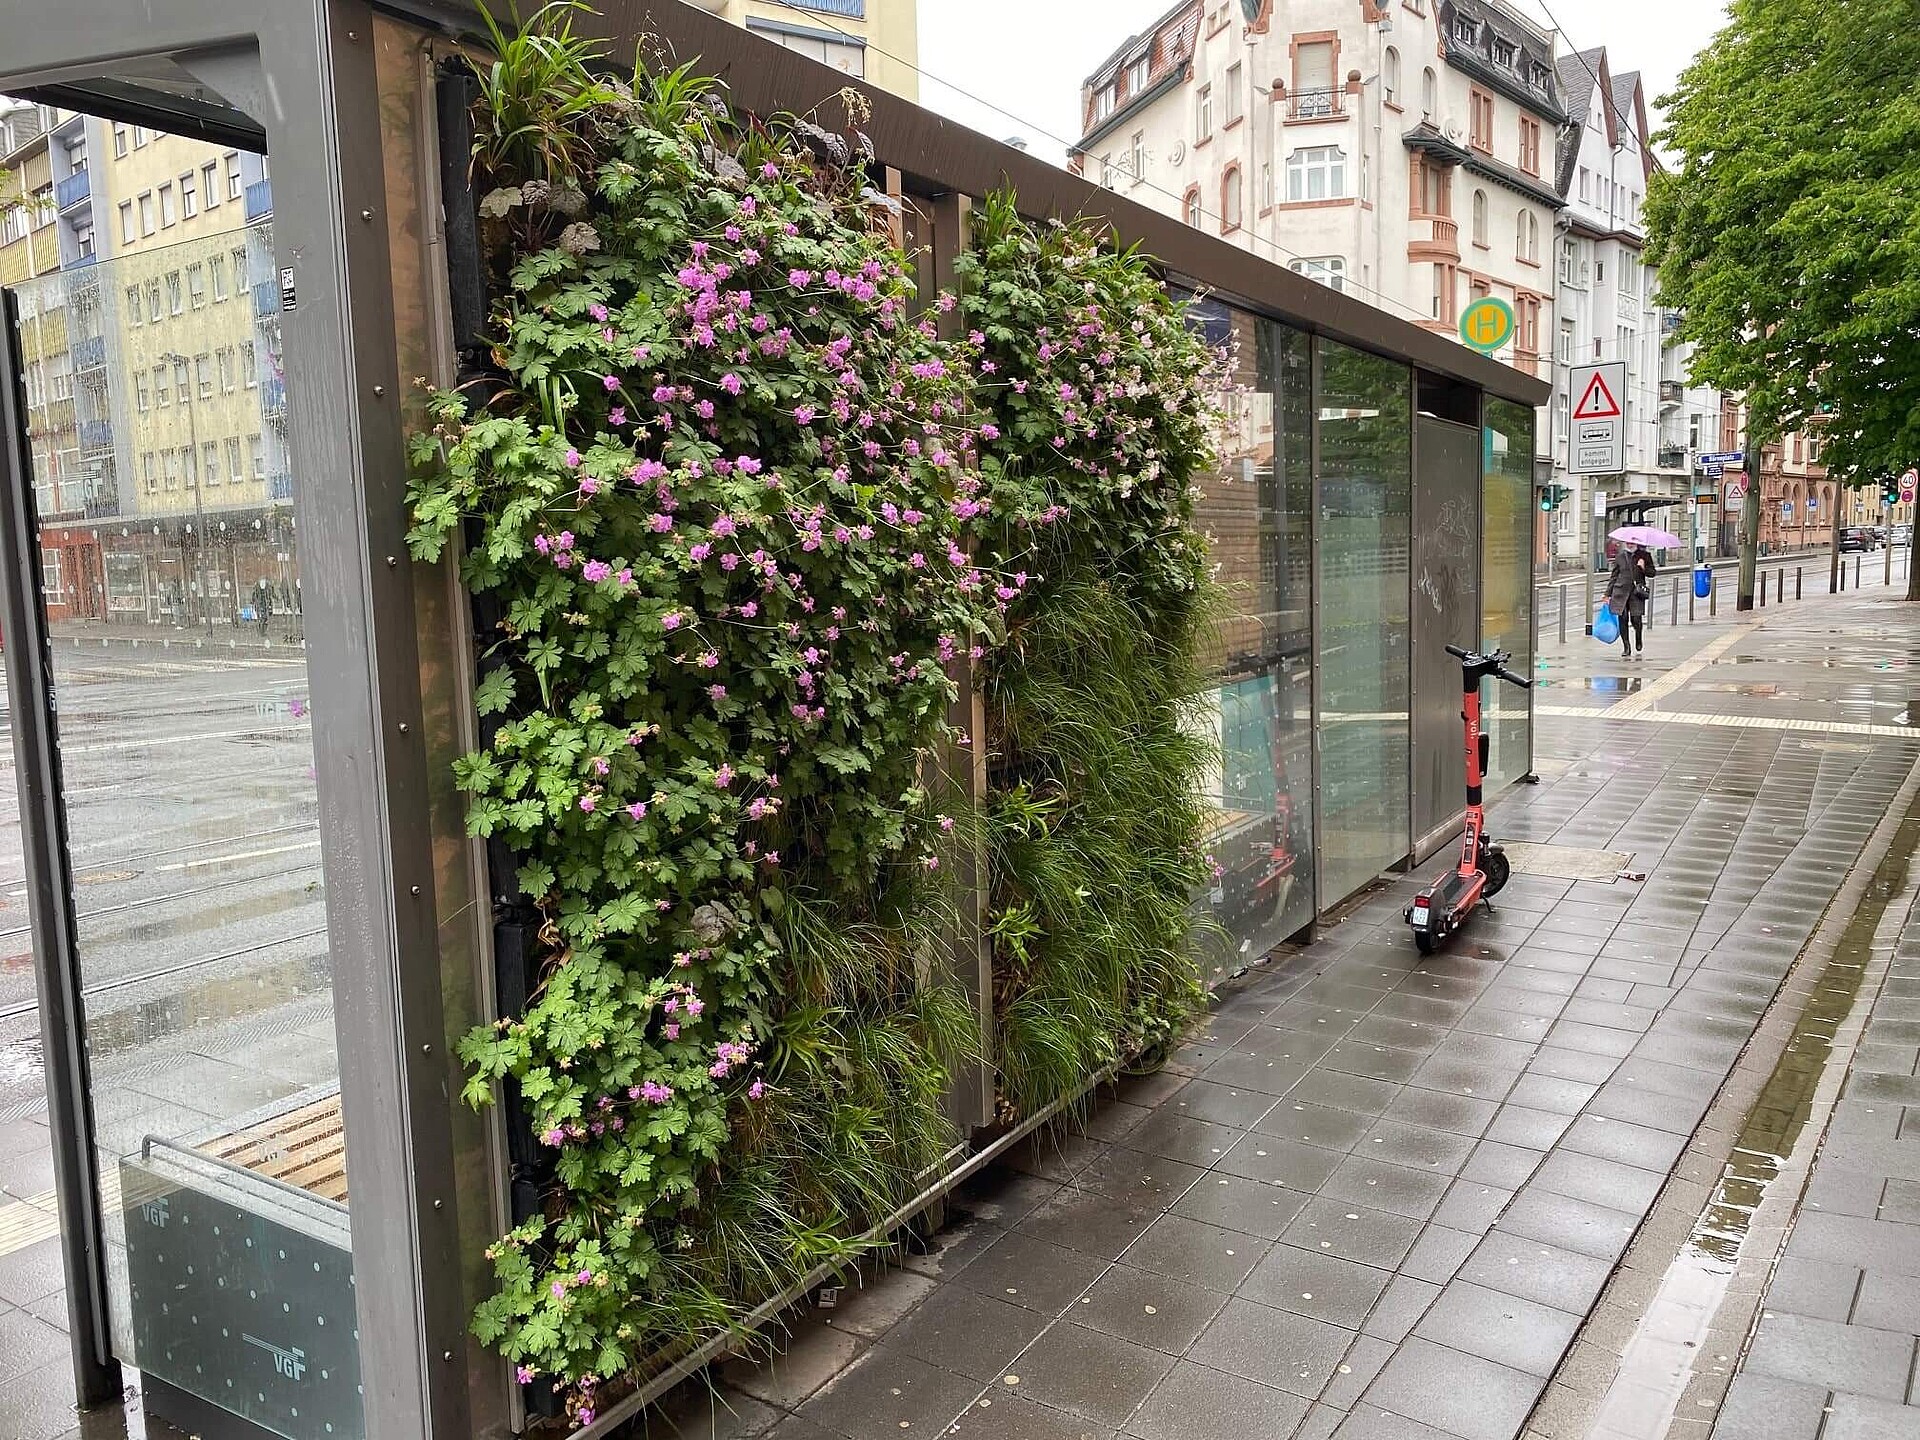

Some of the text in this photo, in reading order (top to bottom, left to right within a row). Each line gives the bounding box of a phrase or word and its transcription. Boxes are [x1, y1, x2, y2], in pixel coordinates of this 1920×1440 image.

[1475, 310, 1498, 338] H
[1903, 475, 1914, 485] 40
[142, 1198, 170, 1228] VGF
[273, 1347, 306, 1381] VGF
